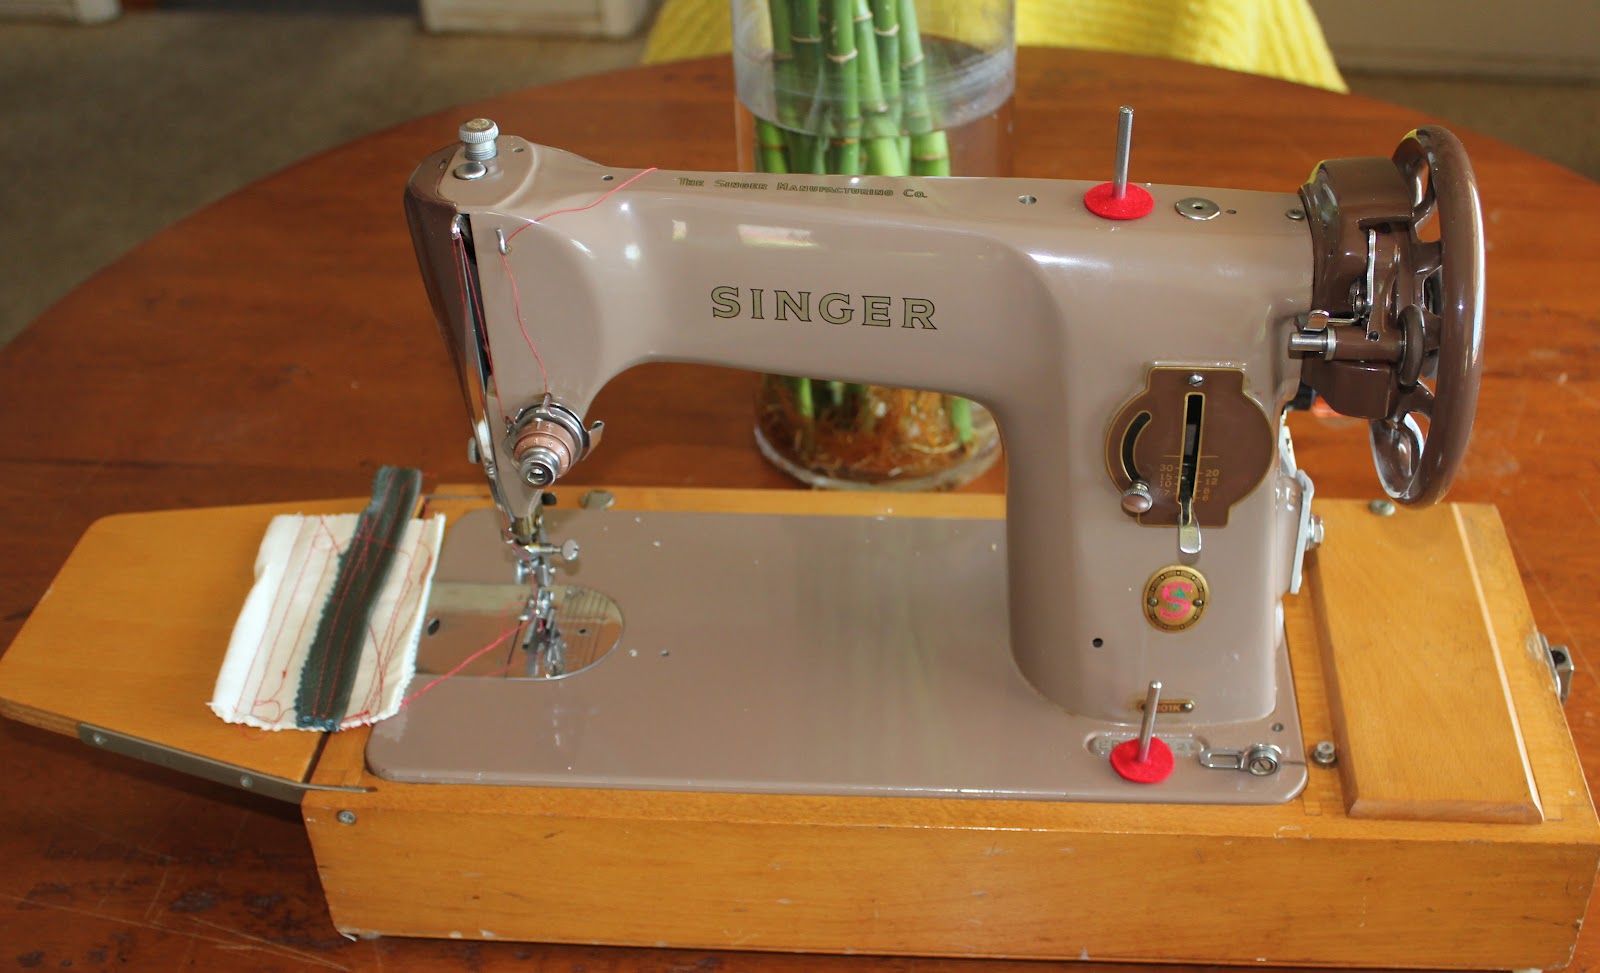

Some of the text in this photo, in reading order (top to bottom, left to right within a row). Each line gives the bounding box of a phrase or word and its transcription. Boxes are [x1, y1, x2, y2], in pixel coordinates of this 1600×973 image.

[711, 286, 938, 330] SINGER
[1160, 464, 1174, 472] 30
[1205, 469, 1220, 477] 20
[1205, 478, 1218, 486] 12
